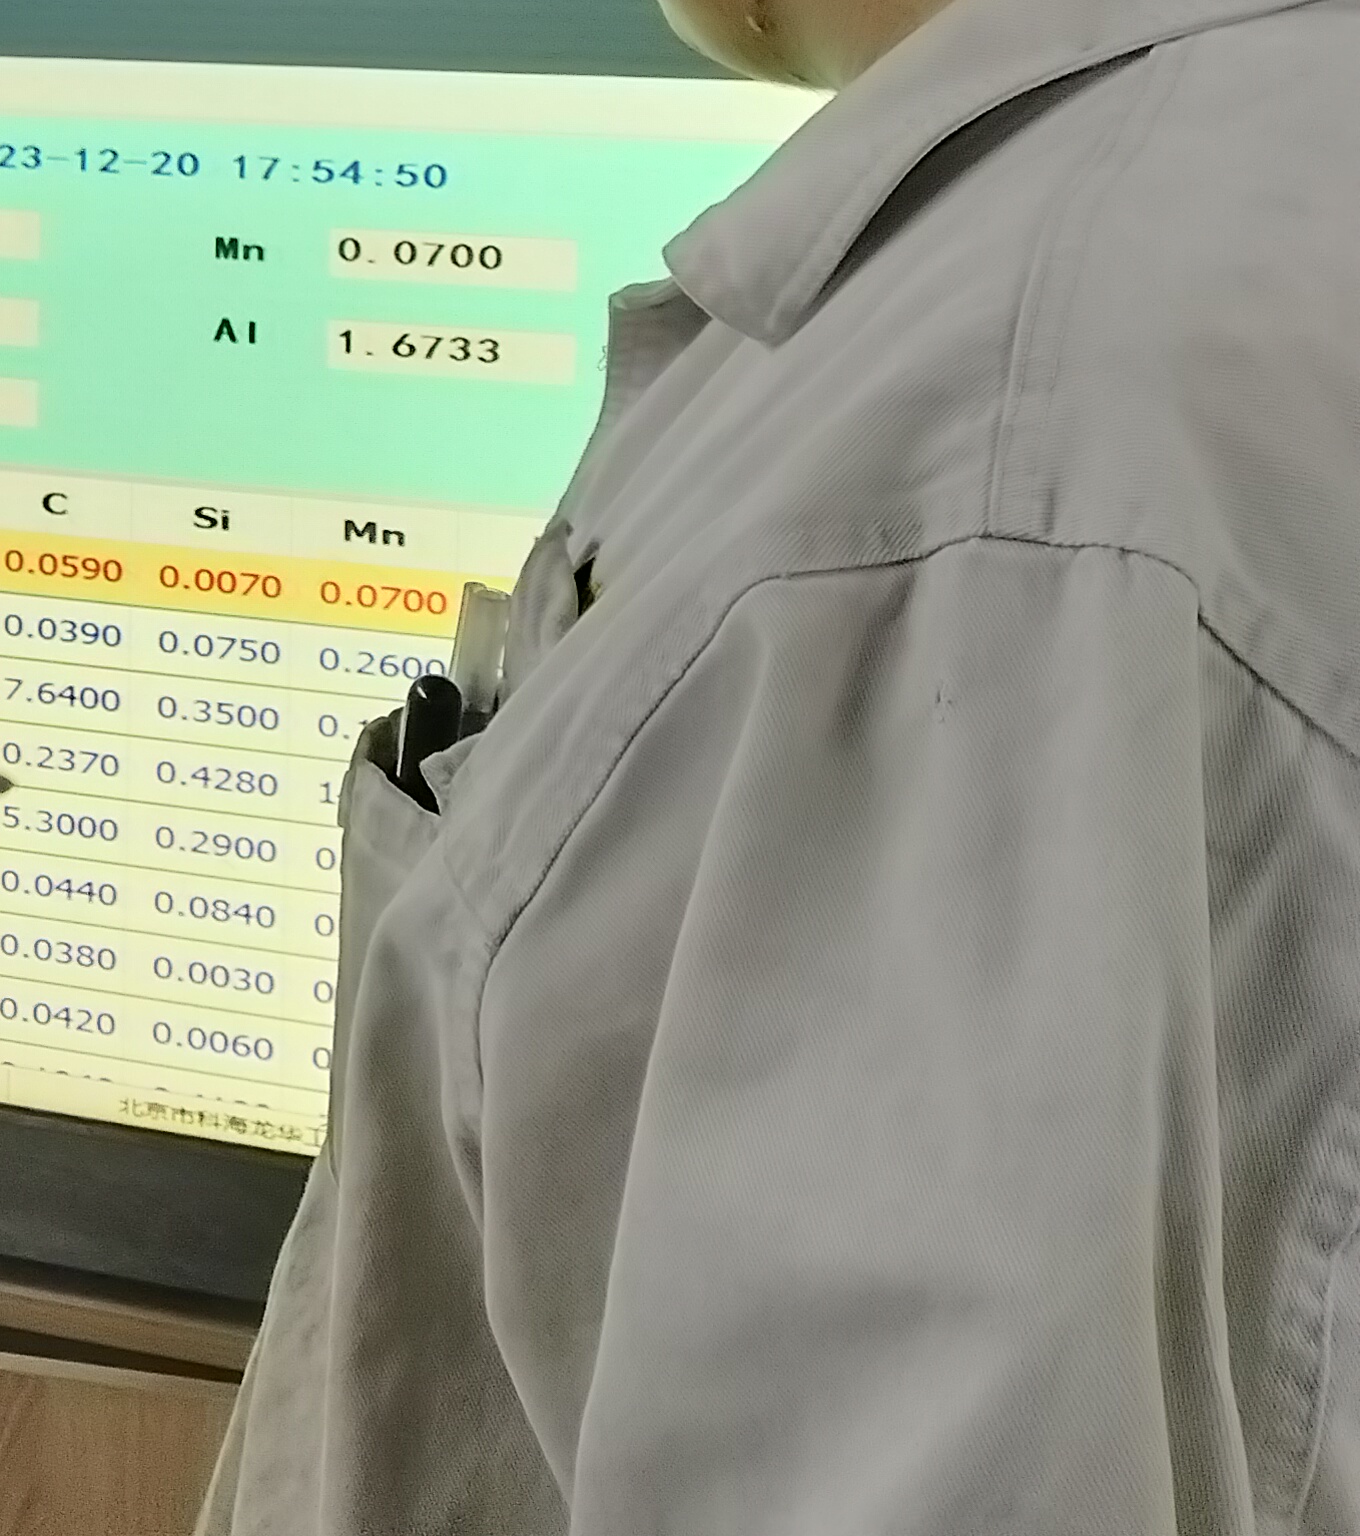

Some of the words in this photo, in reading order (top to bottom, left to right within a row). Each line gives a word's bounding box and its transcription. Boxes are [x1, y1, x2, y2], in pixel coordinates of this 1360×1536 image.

[233, 154, 449, 189] 17:54:50
[214, 237, 266, 263] Mn
[338, 237, 504, 271] 0.0700
[213, 318, 258, 345] Al
[339, 328, 502, 364] 1.6733
[42, 491, 69, 517] C
[192, 506, 230, 532] Si
[343, 519, 407, 547] Mn
[5, 549, 123, 583] 0.0590
[159, 564, 282, 599] 0.0070
[319, 580, 448, 616] 0.0700
[4, 613, 122, 648] 0.0390
[158, 630, 281, 665] 0.0750
[319, 647, 446, 680] 0.2600
[3, 677, 121, 713] 7.6400
[157, 695, 280, 732] 0.3500
[2, 742, 120, 778] 0.2370
[156, 761, 278, 798] 0.4280
[2, 805, 119, 843] 5.3000
[155, 826, 277, 863] 0.2900
[1, 869, 118, 907] 0.0440
[154, 891, 276, 929] 0.0840
[0, 933, 117, 971] 0.0380
[153, 956, 275, 995] 0.0030
[0, 997, 116, 1036] 0.0420
[152, 1021, 274, 1062] 0.0060
